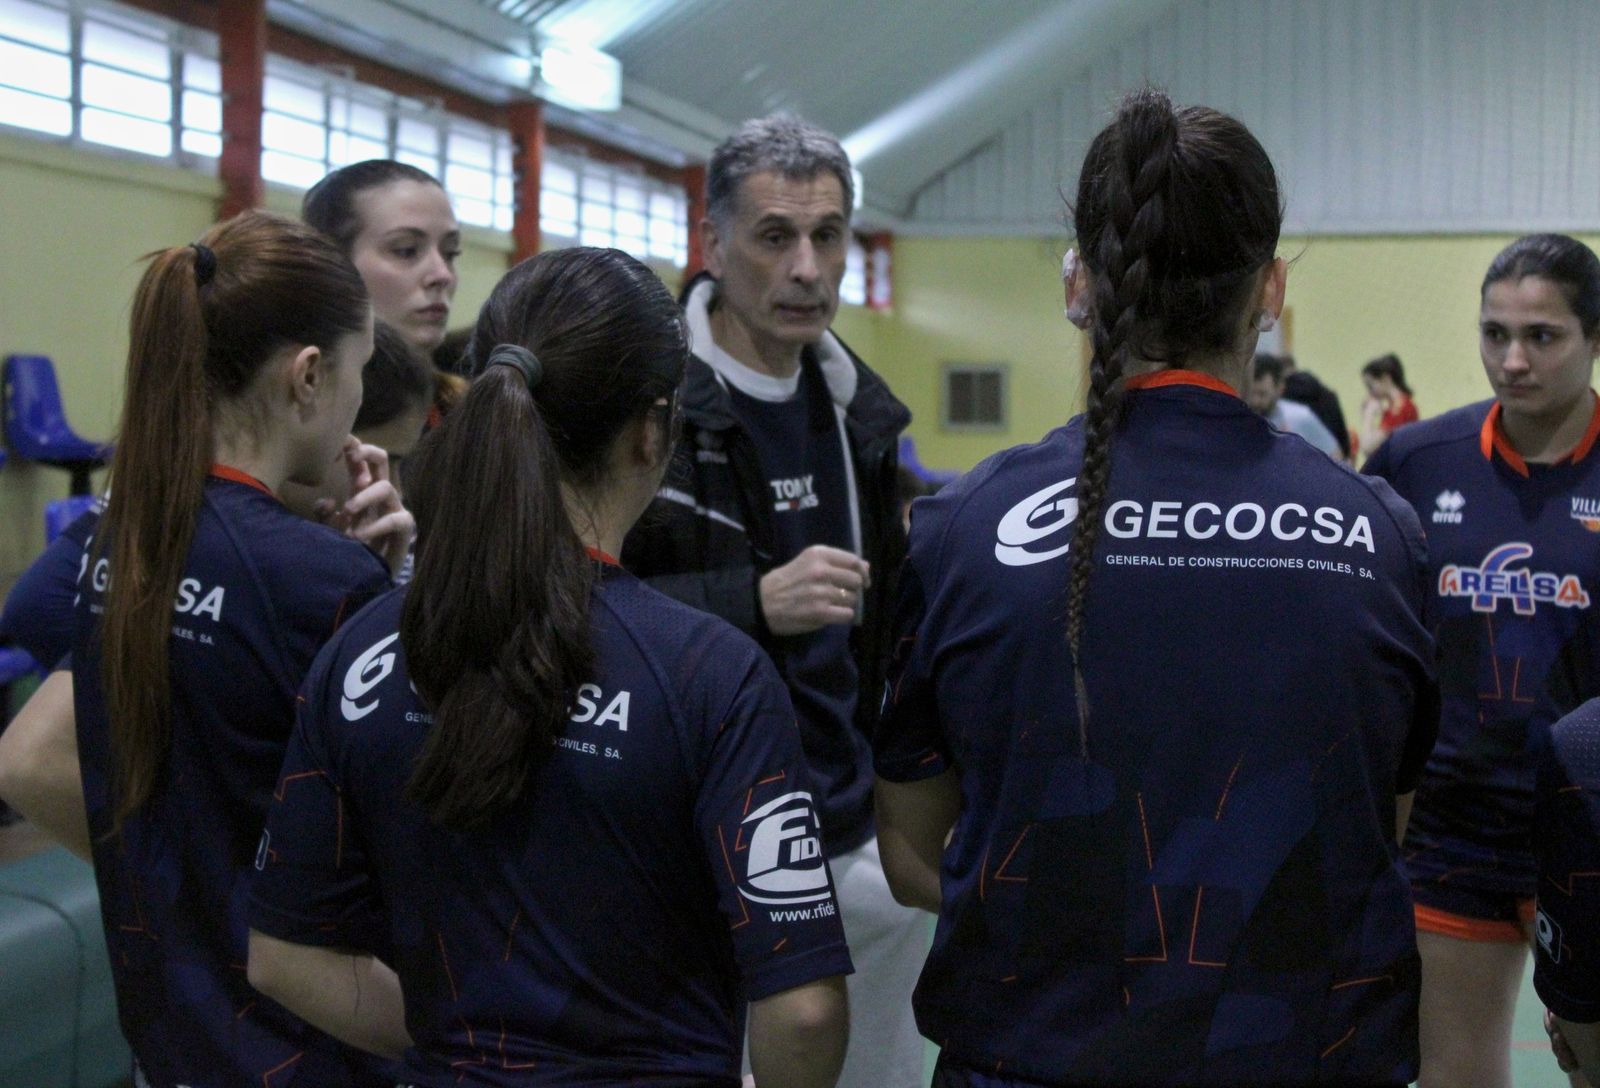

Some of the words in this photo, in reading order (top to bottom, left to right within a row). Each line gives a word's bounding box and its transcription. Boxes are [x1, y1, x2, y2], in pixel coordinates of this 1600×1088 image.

[1104, 500, 1375, 553] GECOCSA
[1106, 554, 1165, 567] GENERAL
[1168, 556, 1185, 567] DE
[1188, 556, 1304, 569] CONSTRUCCIONES
[1307, 559, 1354, 575] CIVILES,
[1359, 567, 1376, 580] SA.
[604, 747, 623, 760] SA.
